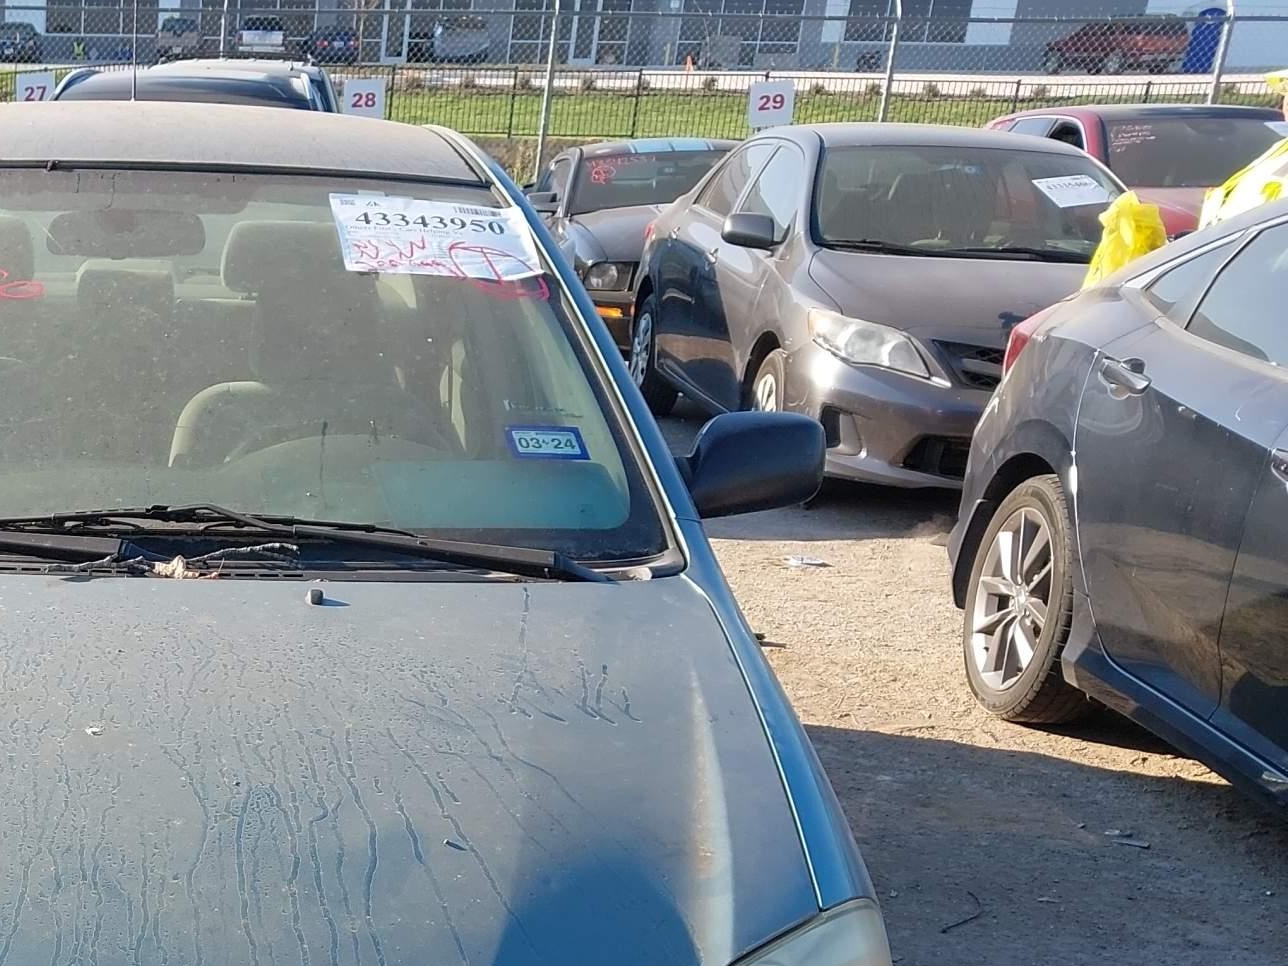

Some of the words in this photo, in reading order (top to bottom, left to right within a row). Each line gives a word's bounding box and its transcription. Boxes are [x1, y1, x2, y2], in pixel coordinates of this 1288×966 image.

[24, 86, 47, 101] 27
[352, 92, 376, 108] 28
[758, 94, 785, 111] 29
[355, 211, 505, 236] 43343950
